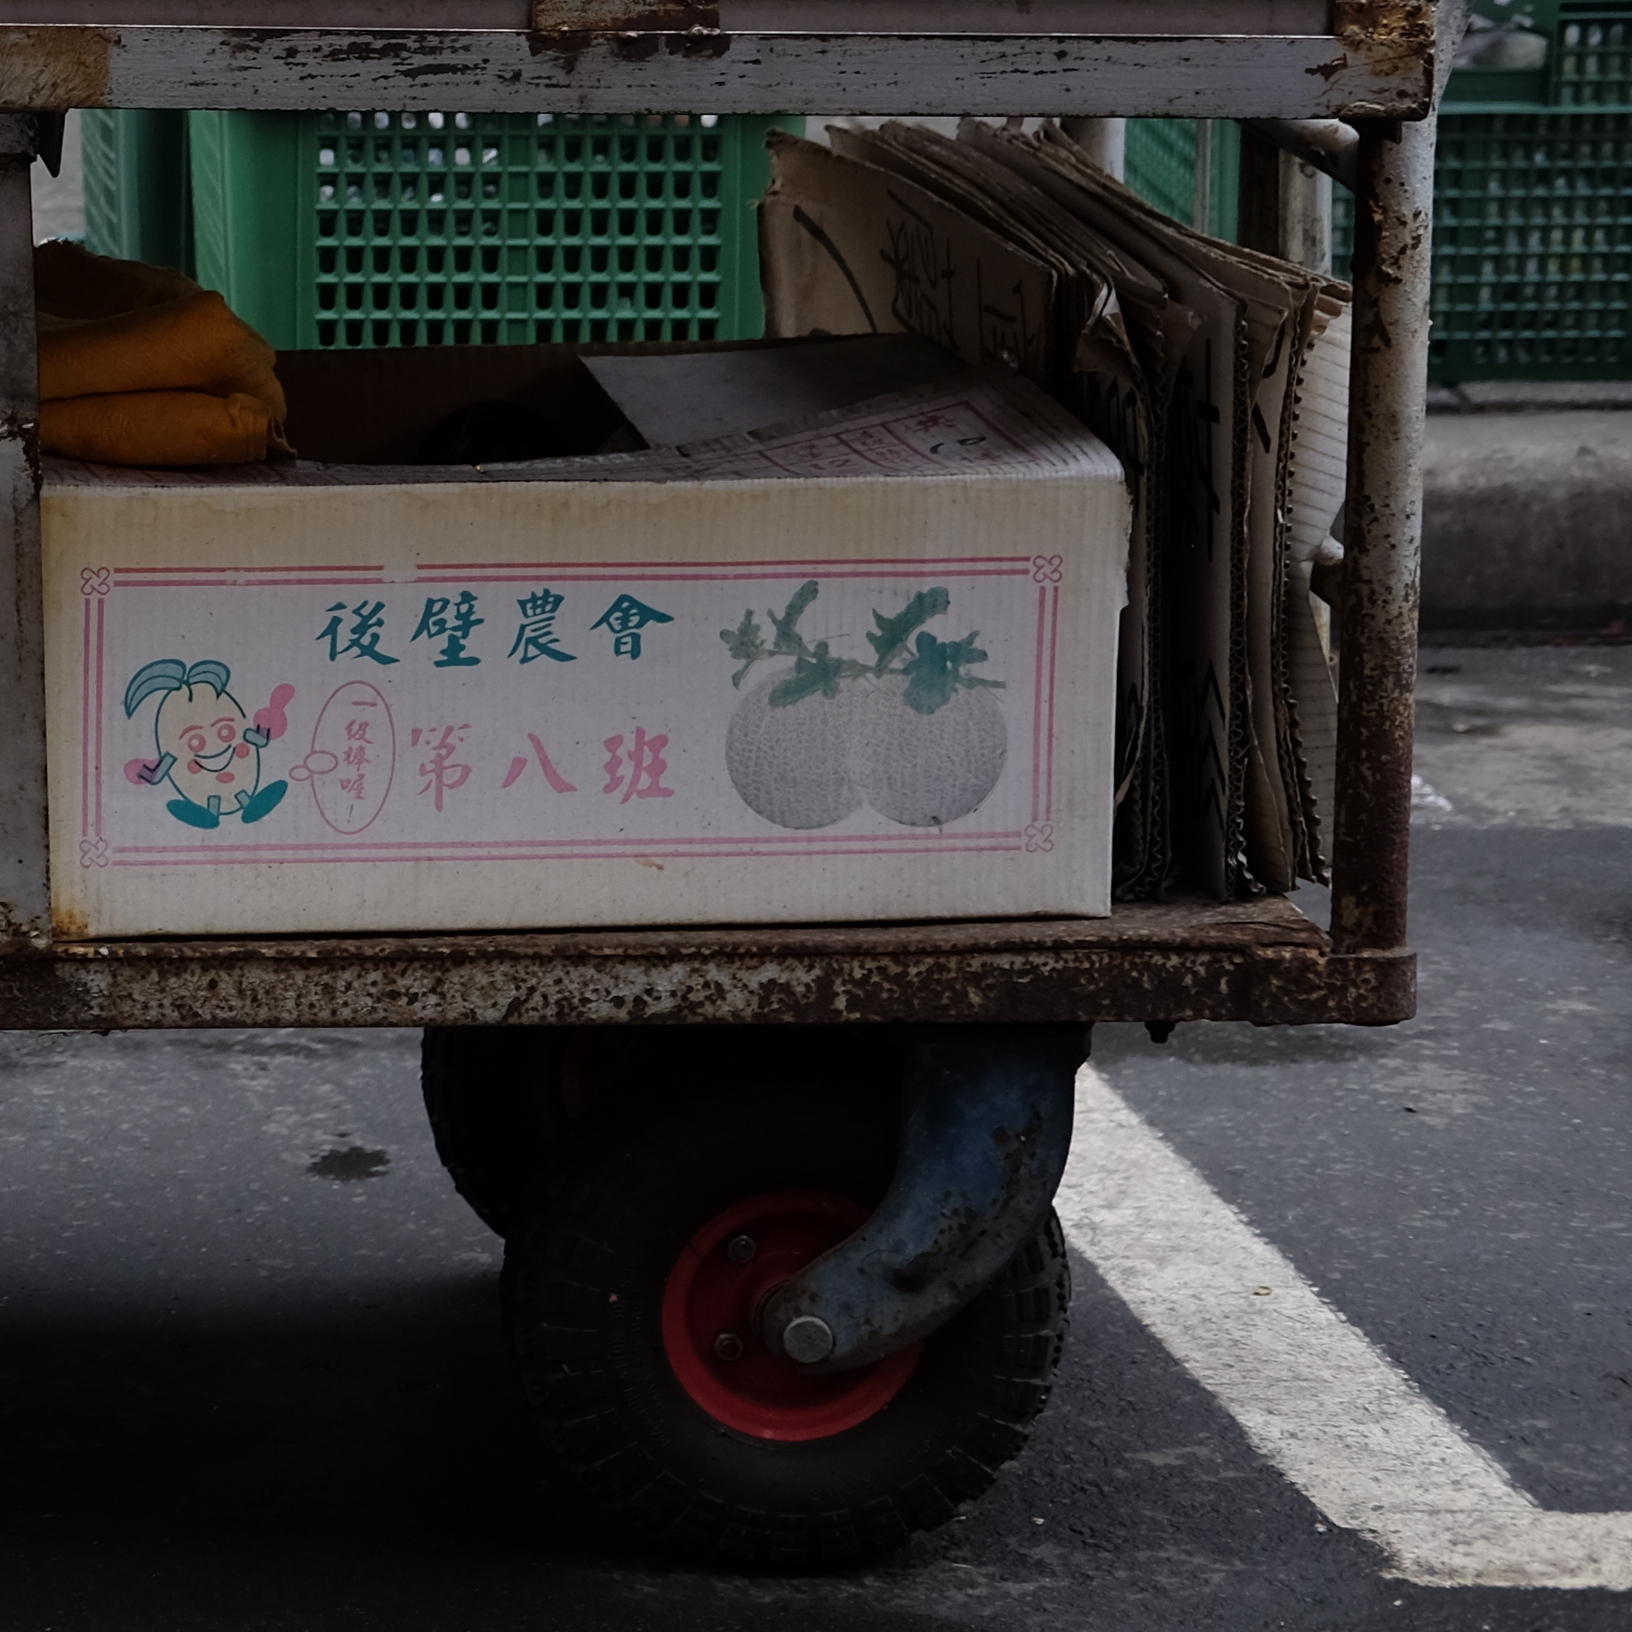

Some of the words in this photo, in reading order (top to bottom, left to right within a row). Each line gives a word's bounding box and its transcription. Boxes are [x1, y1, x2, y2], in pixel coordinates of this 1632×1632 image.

[315, 588, 676, 668] 後壁農會
[411, 723, 676, 812] 第八班
